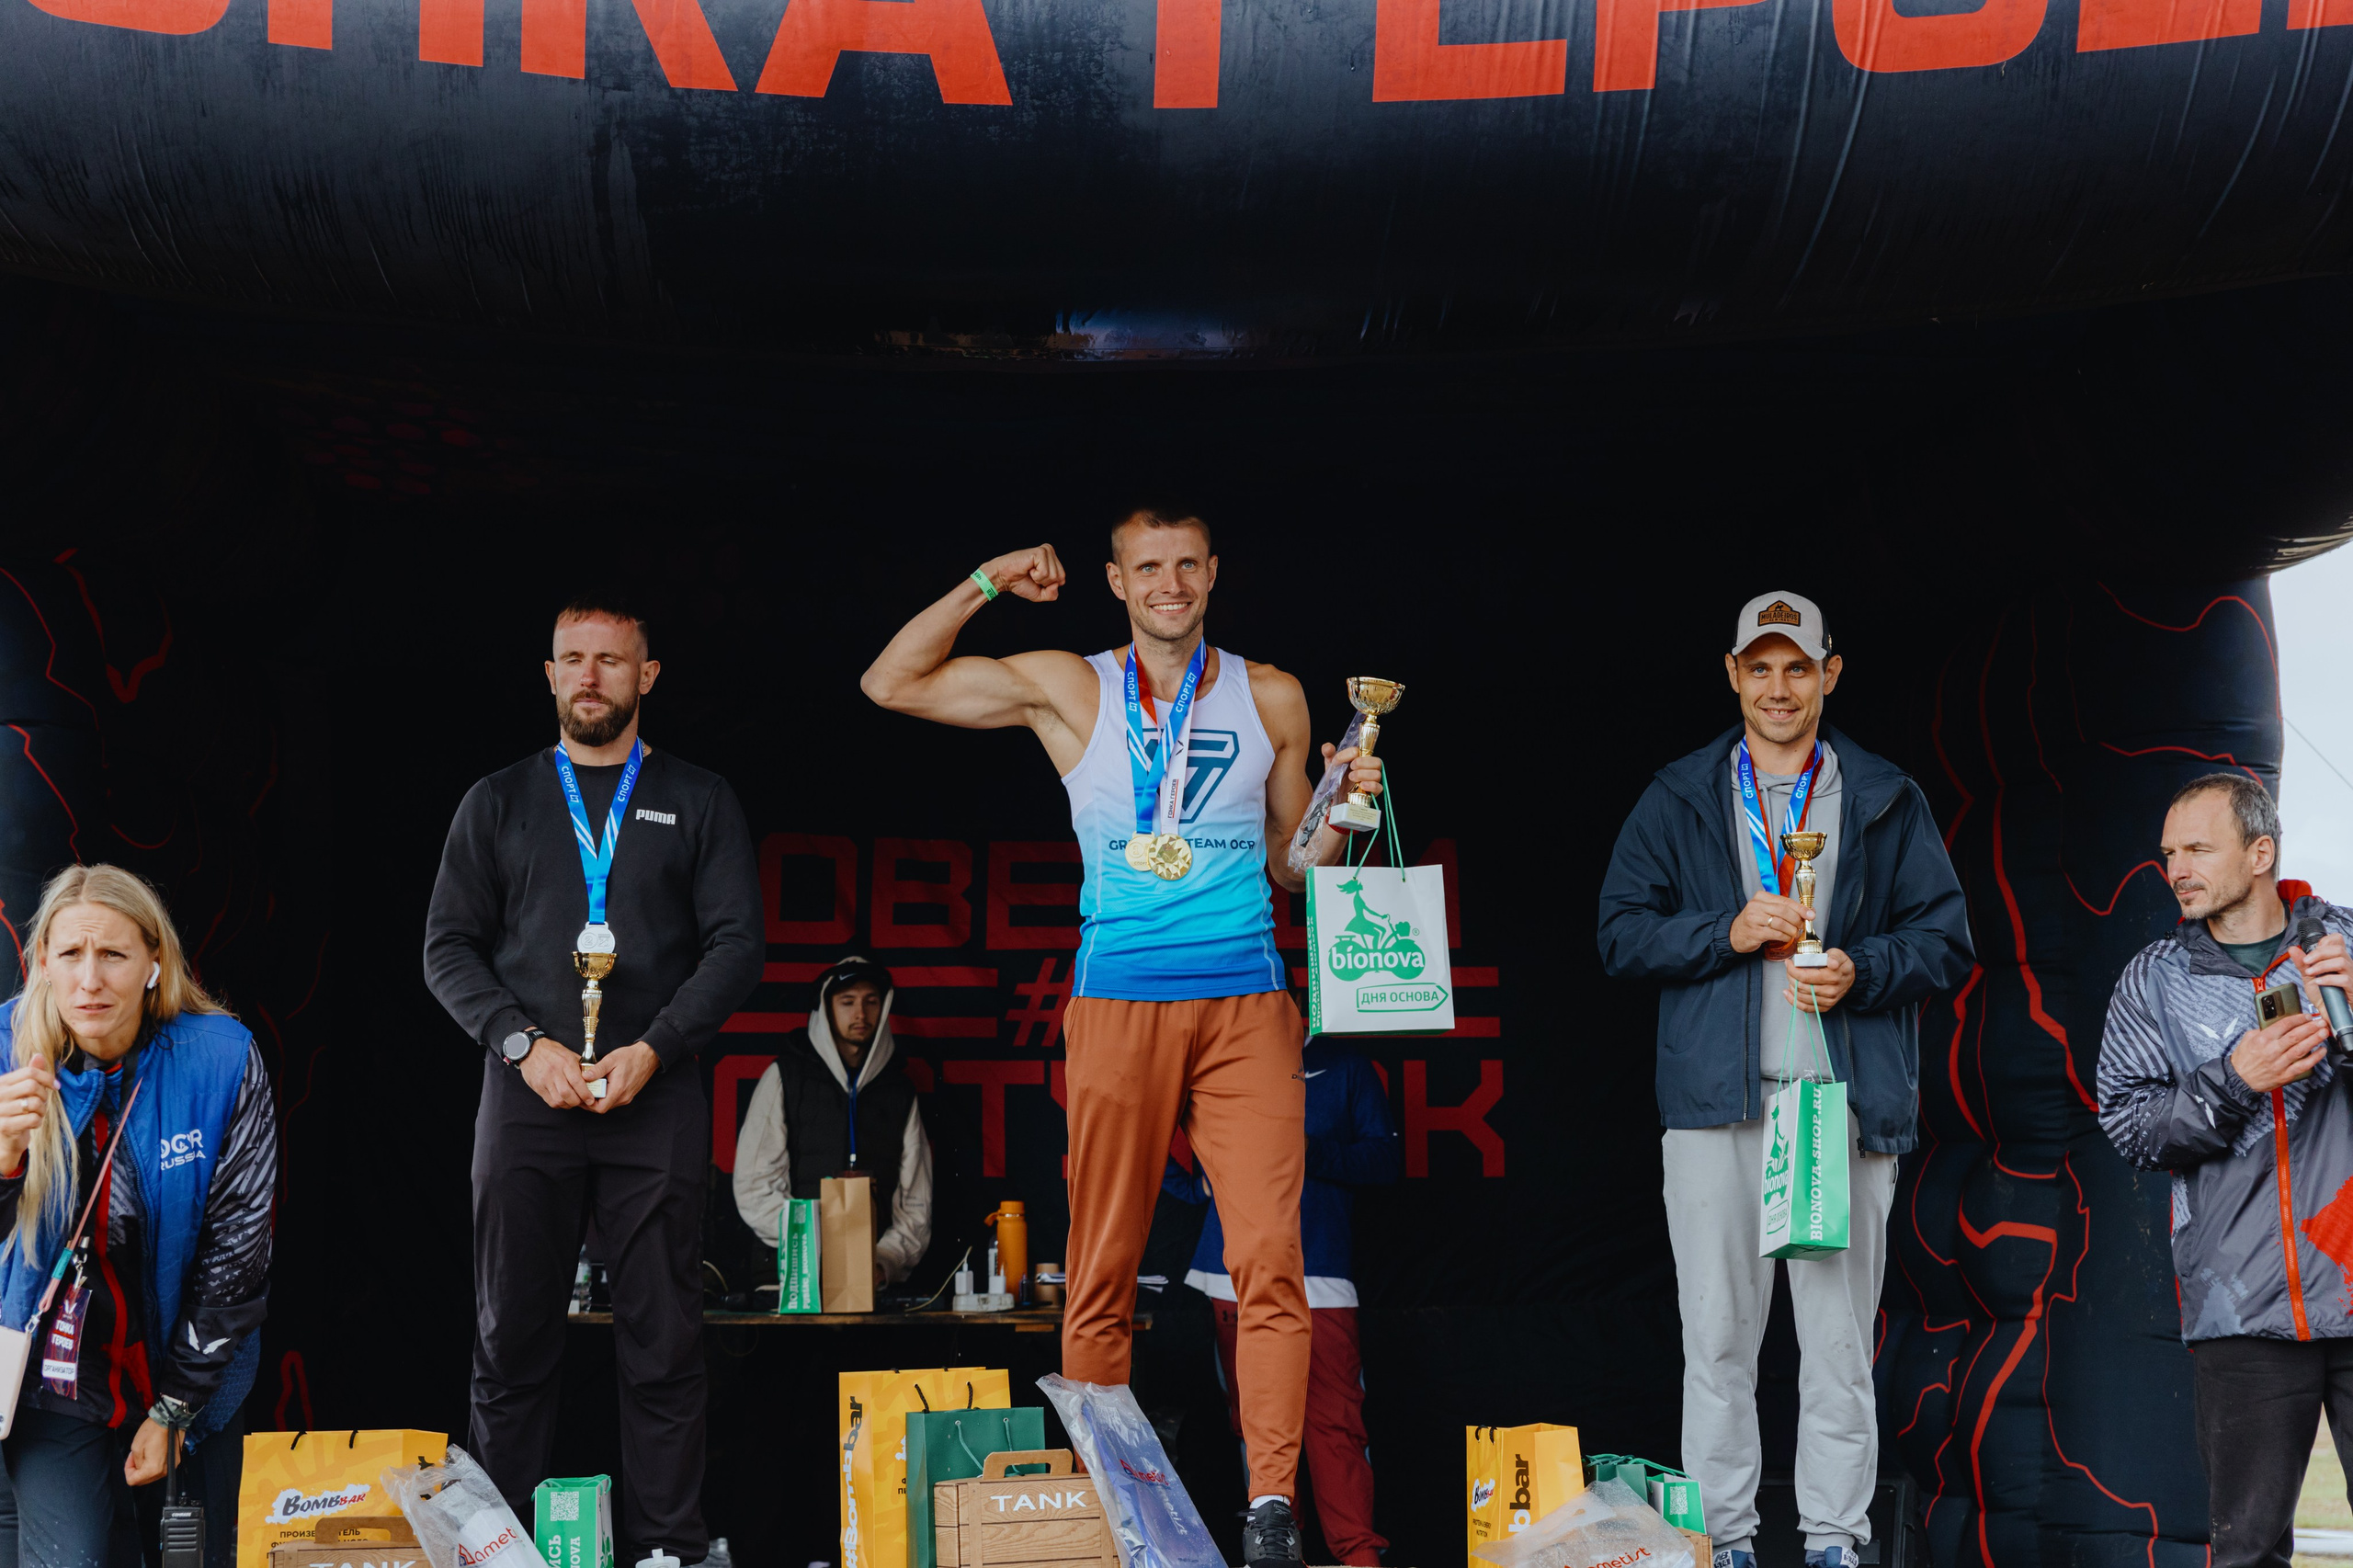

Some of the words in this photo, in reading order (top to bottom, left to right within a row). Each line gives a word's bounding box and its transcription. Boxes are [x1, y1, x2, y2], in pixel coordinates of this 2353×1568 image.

[1127, 671, 1137, 701] СПОРТ
[1175, 682, 1193, 713] СПОРТ
[561, 766, 577, 794] СПОРТ
[617, 773, 633, 802] СПОРТ
[1742, 772, 1754, 799] СПОРТ
[1795, 772, 1810, 799] СПОРТ
[635, 809, 676, 825] PUMA
[1188, 837, 1226, 849] TEAM
[1230, 839, 1256, 850] OCR
[1332, 945, 1425, 971] bionova
[1361, 992, 1387, 1005] ДНЯ
[1390, 991, 1440, 1003] ОСНОВА
[1810, 1086, 1823, 1242] BIONOVA-SHOP.RU
[990, 1491, 1086, 1512] TANK
[279, 1528, 361, 1539] ПРОИЗВТЕЛЬ
[1587, 1546, 1652, 1568] metist
